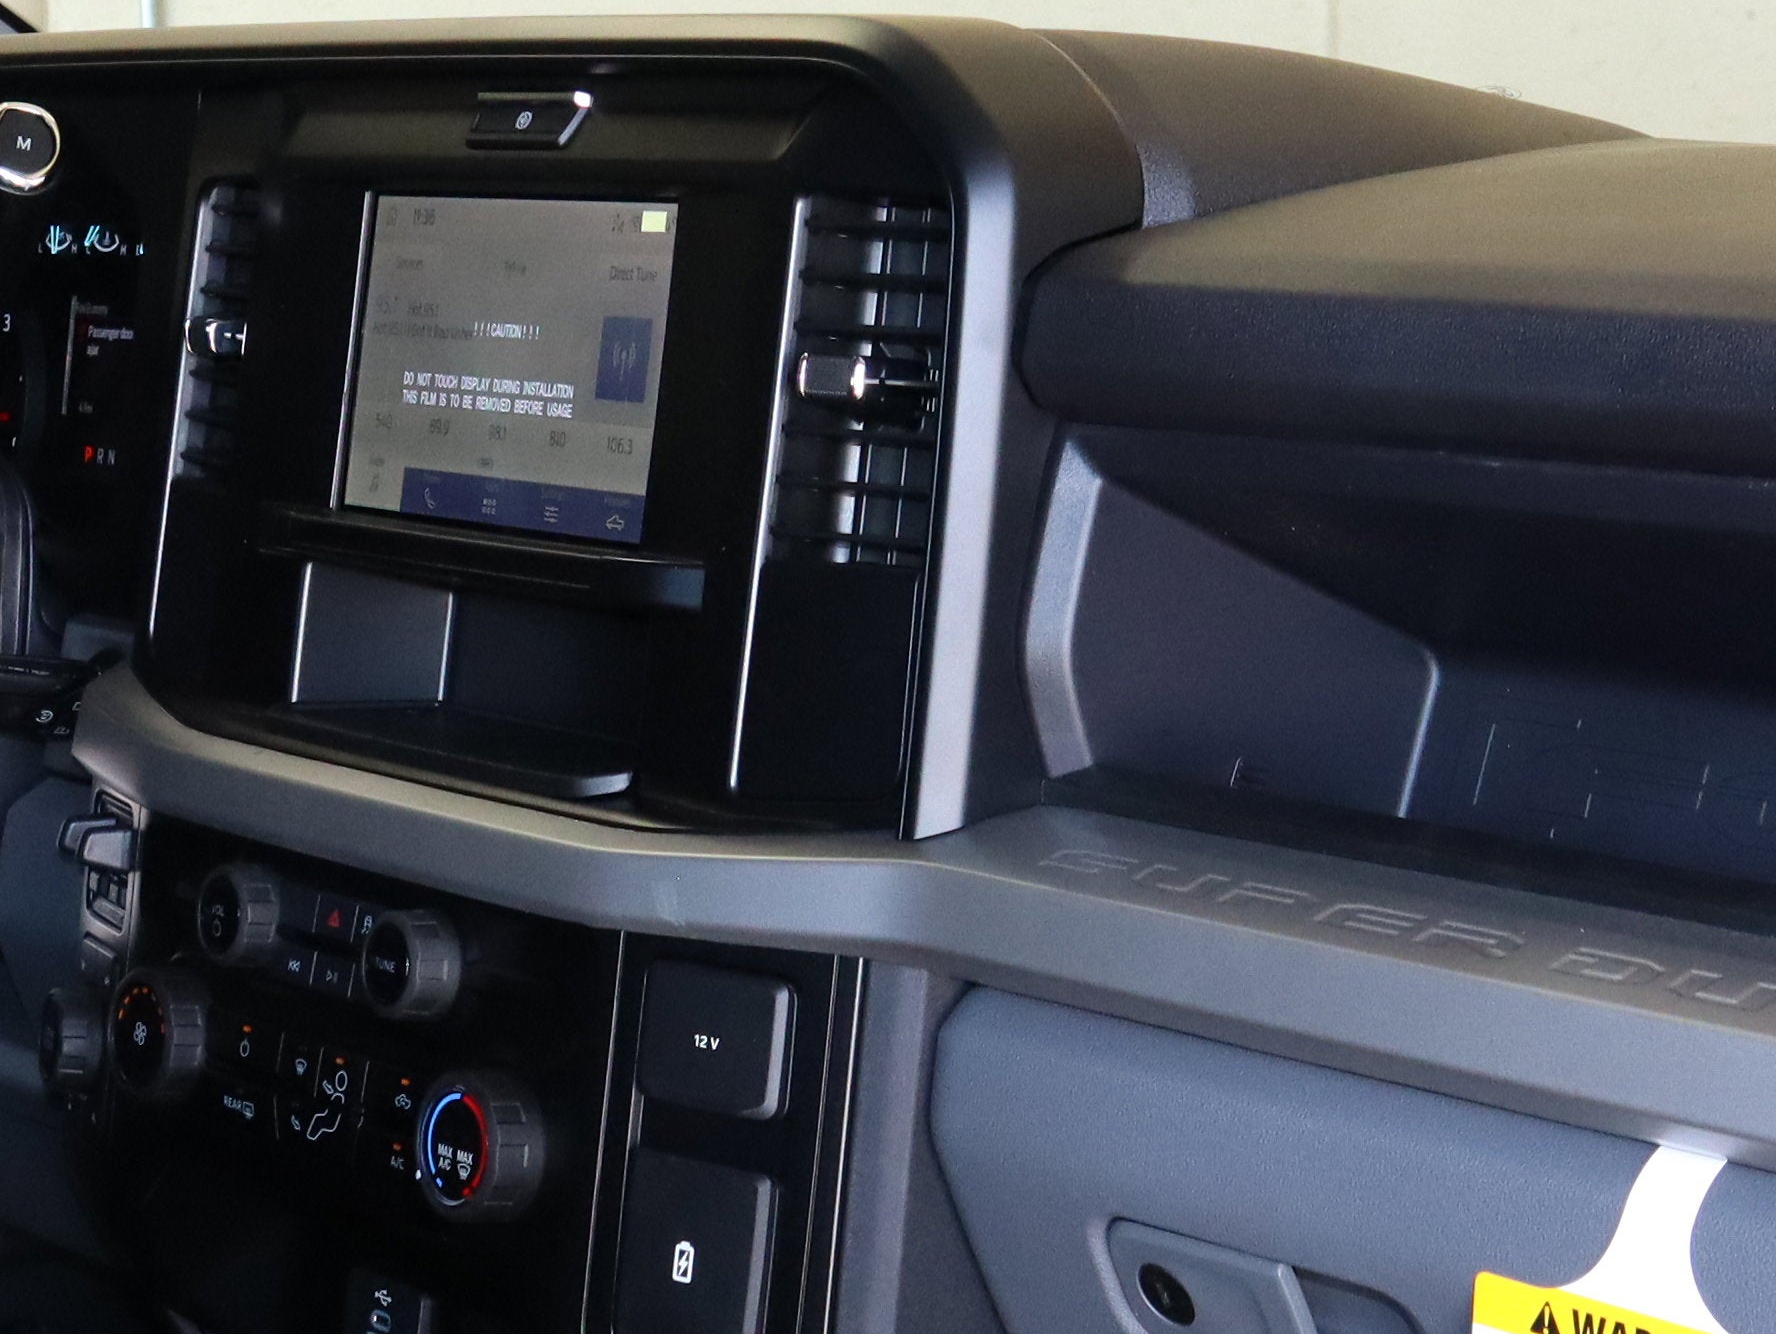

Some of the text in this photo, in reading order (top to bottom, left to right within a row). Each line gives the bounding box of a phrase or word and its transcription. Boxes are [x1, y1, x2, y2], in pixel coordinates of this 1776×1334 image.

[16, 136, 31, 151] M
[403, 370, 574, 399] DO NOT TOUCH DISPLAY DURING INSTALLATION
[402, 389, 573, 418] THIS FILM IS TO BE REMOVED BEFORE USAGE
[84, 445, 117, 466] P R N
[1037, 848, 1526, 960] SUPER
[223, 1095, 243, 1112] REAR
[437, 1143, 453, 1159] MAX
[456, 1149, 474, 1166] MAX
[437, 1157, 452, 1171] A/C
